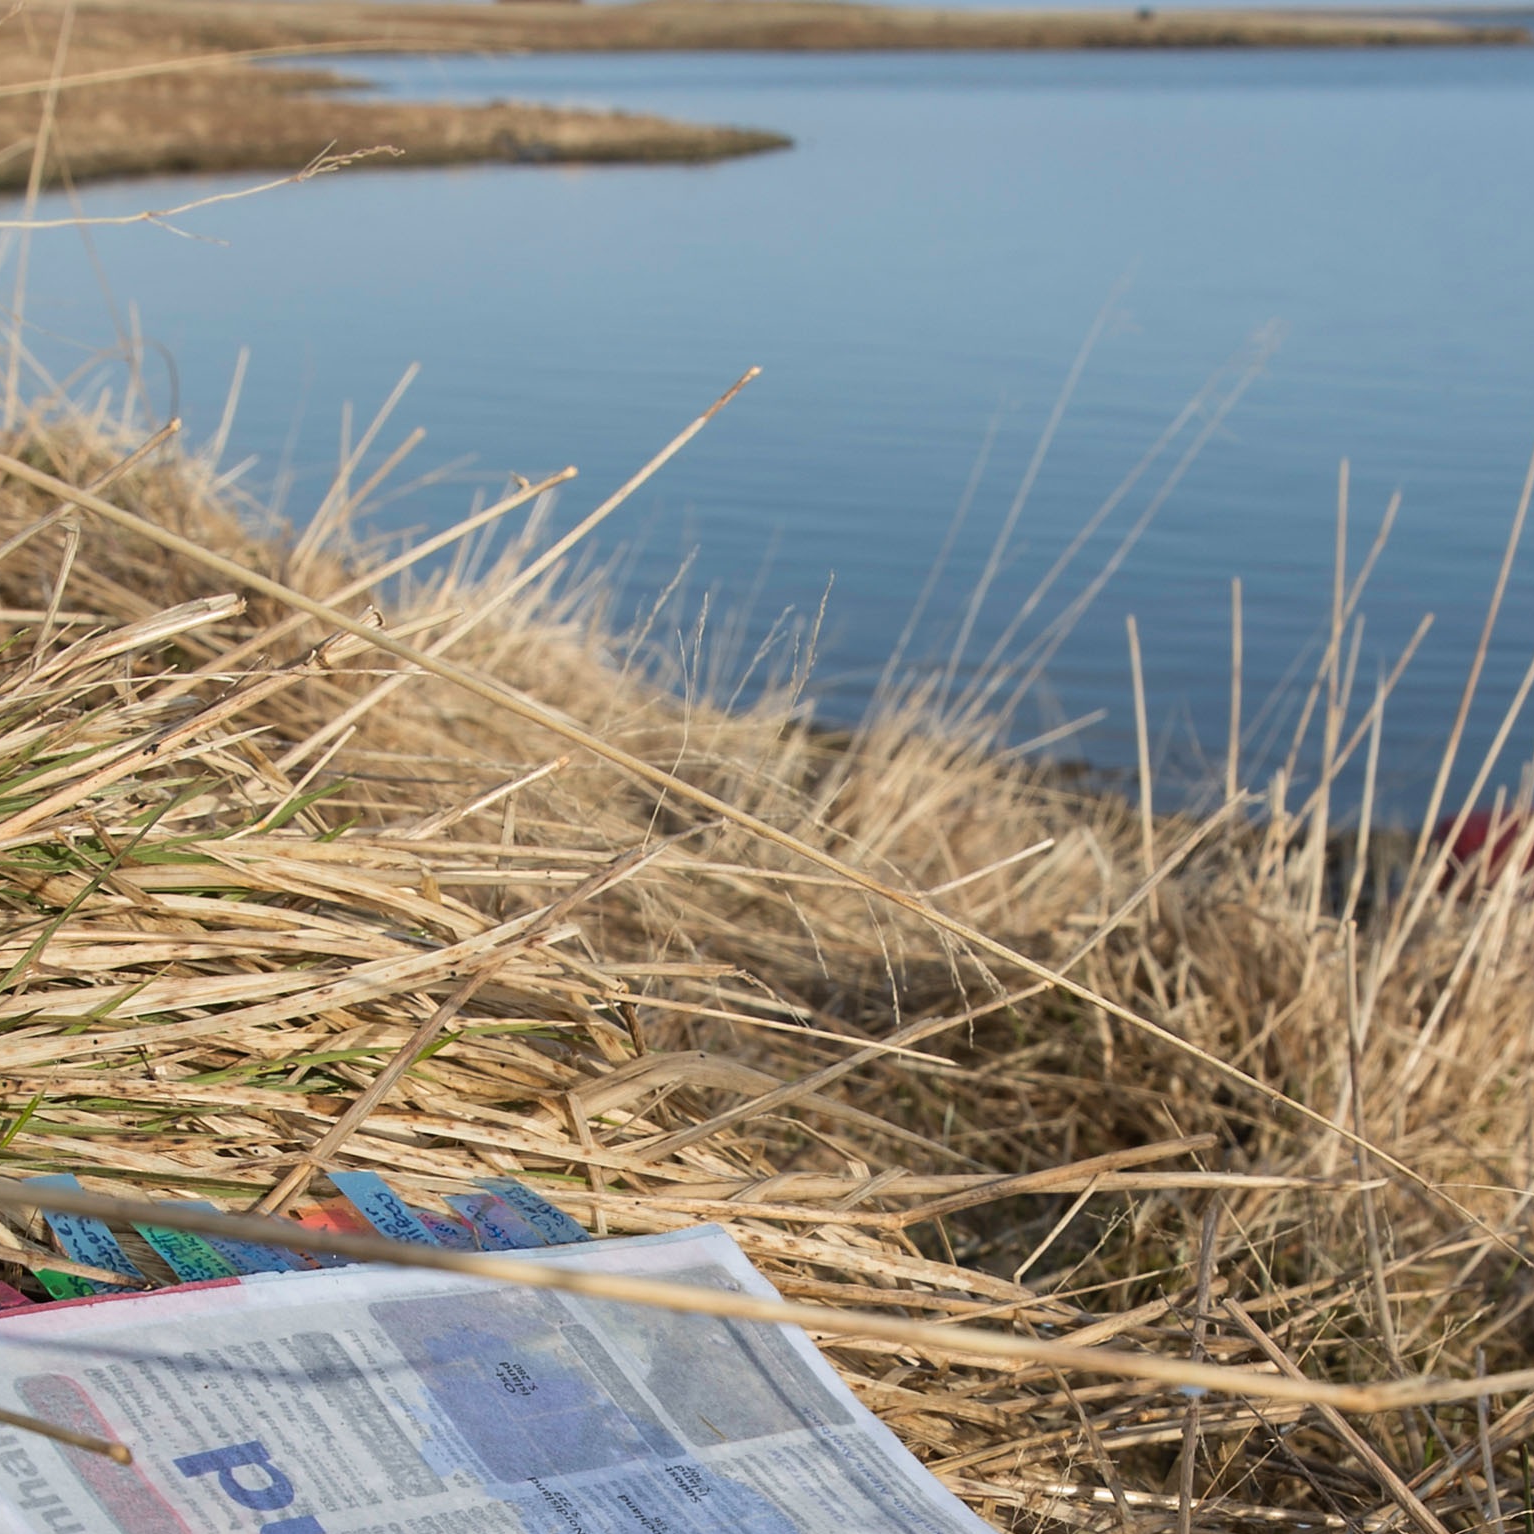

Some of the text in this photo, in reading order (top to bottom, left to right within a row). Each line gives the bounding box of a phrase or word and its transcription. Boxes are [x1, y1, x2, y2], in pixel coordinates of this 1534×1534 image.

[489, 1368, 518, 1392] Ost-
[660, 1464, 701, 1502] Südost-
[526, 1477, 587, 1534] Nordisland
